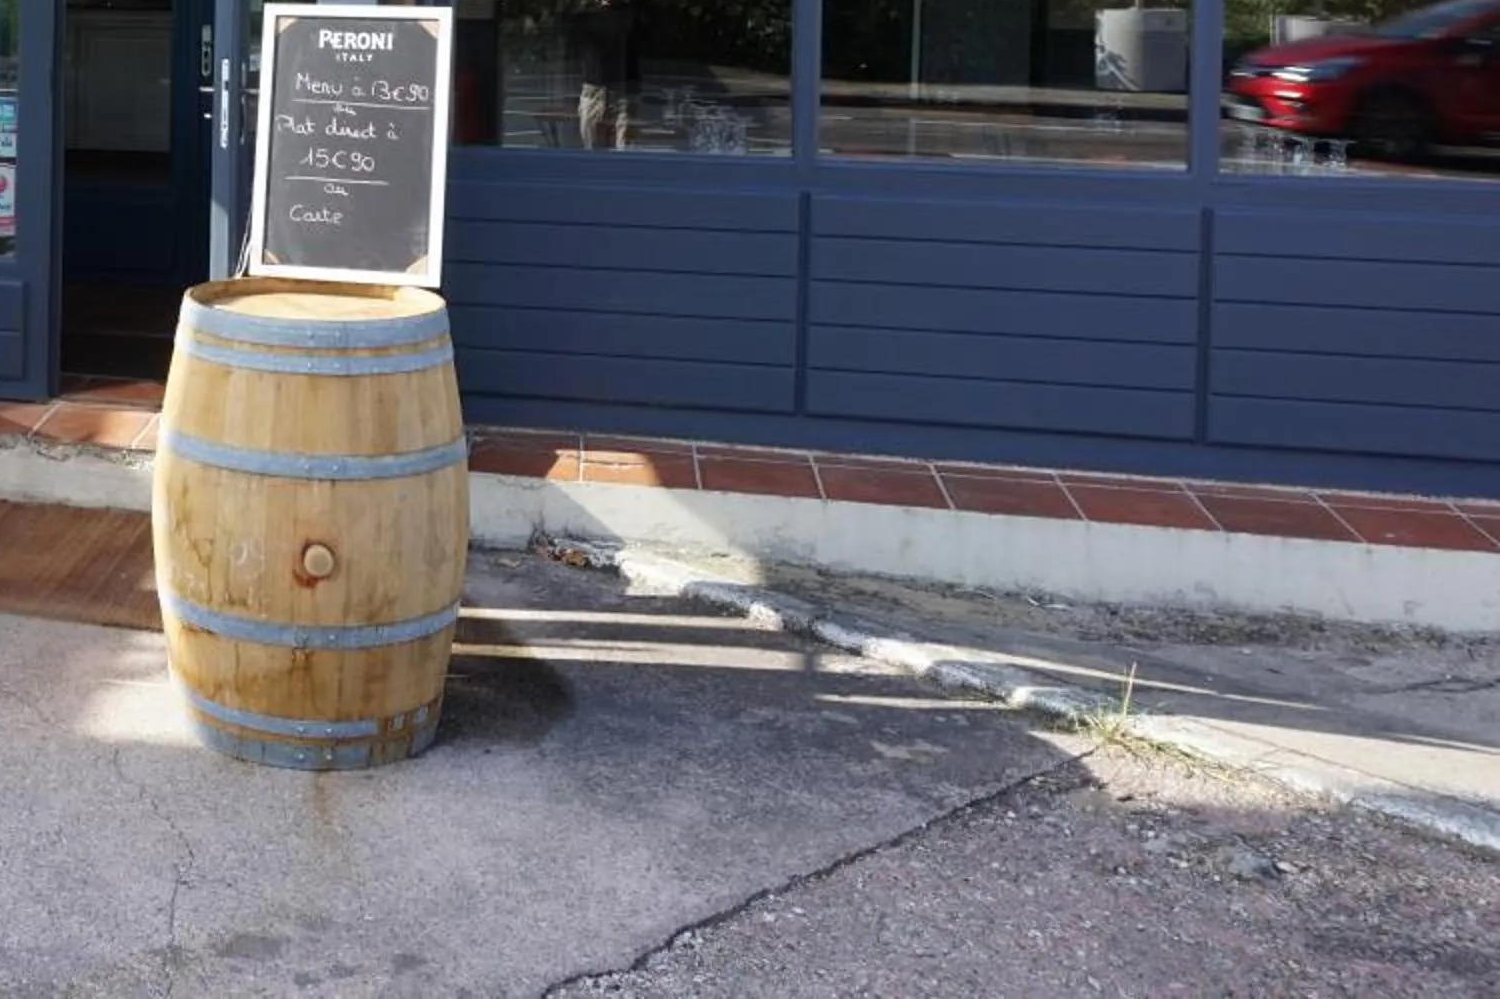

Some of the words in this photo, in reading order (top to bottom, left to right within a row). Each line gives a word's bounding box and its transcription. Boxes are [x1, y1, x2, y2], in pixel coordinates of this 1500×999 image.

[319, 29, 394, 51] PERONI
[335, 52, 373, 62] ITALY
[295, 72, 343, 96] Menu
[275, 114, 316, 134] Plat
[290, 204, 344, 227] Carte
